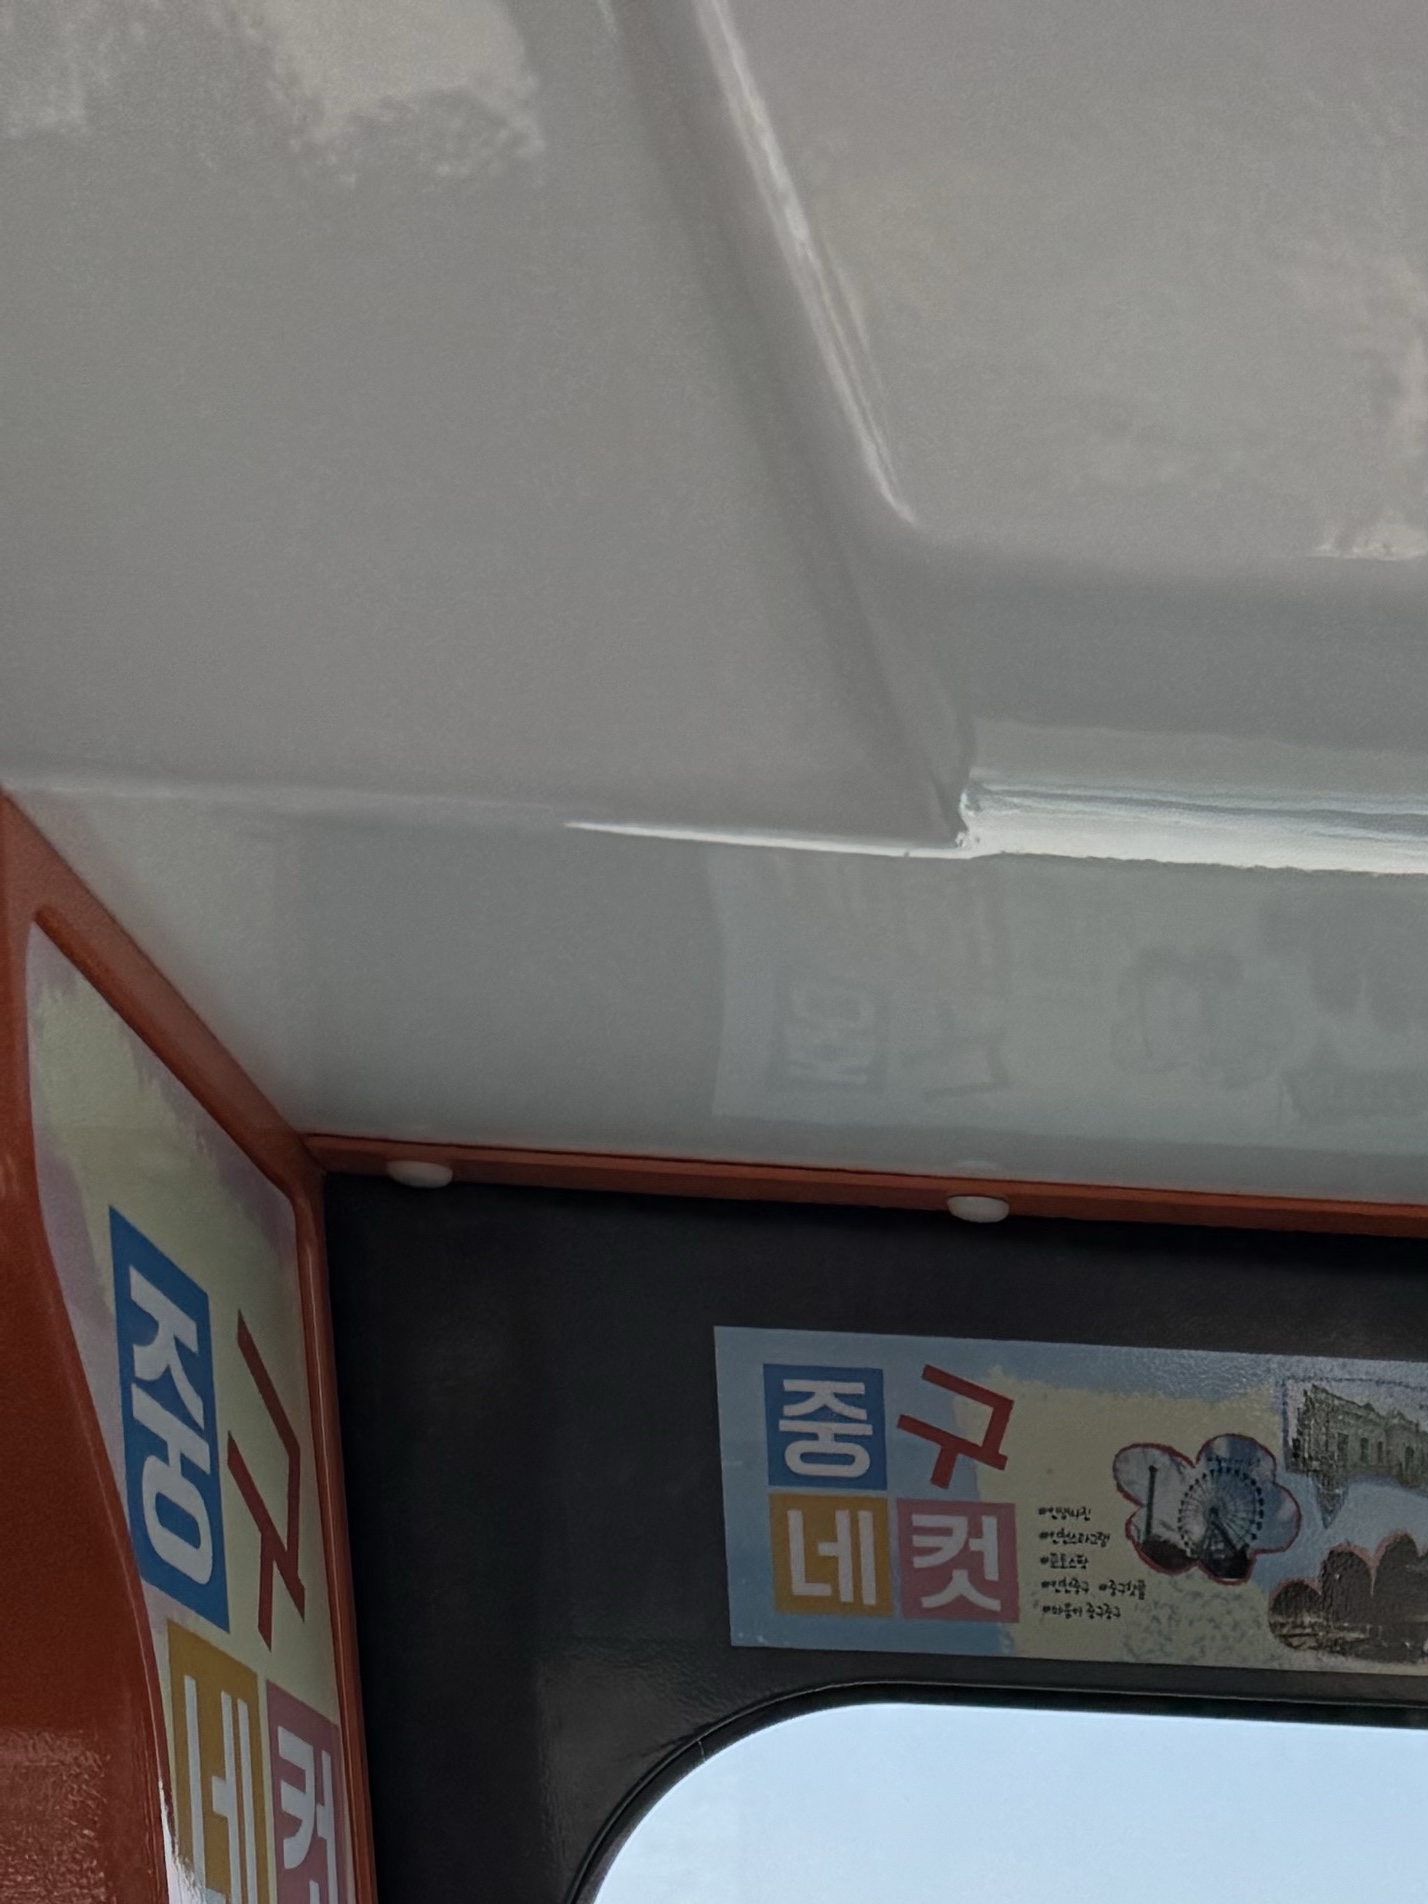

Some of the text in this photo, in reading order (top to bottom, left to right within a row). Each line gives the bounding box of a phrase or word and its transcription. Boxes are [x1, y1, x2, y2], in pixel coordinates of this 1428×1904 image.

[129, 1266, 305, 1652] 중구
[778, 1364, 1014, 1489] 중구
[785, 1505, 1000, 1612] 네컷
